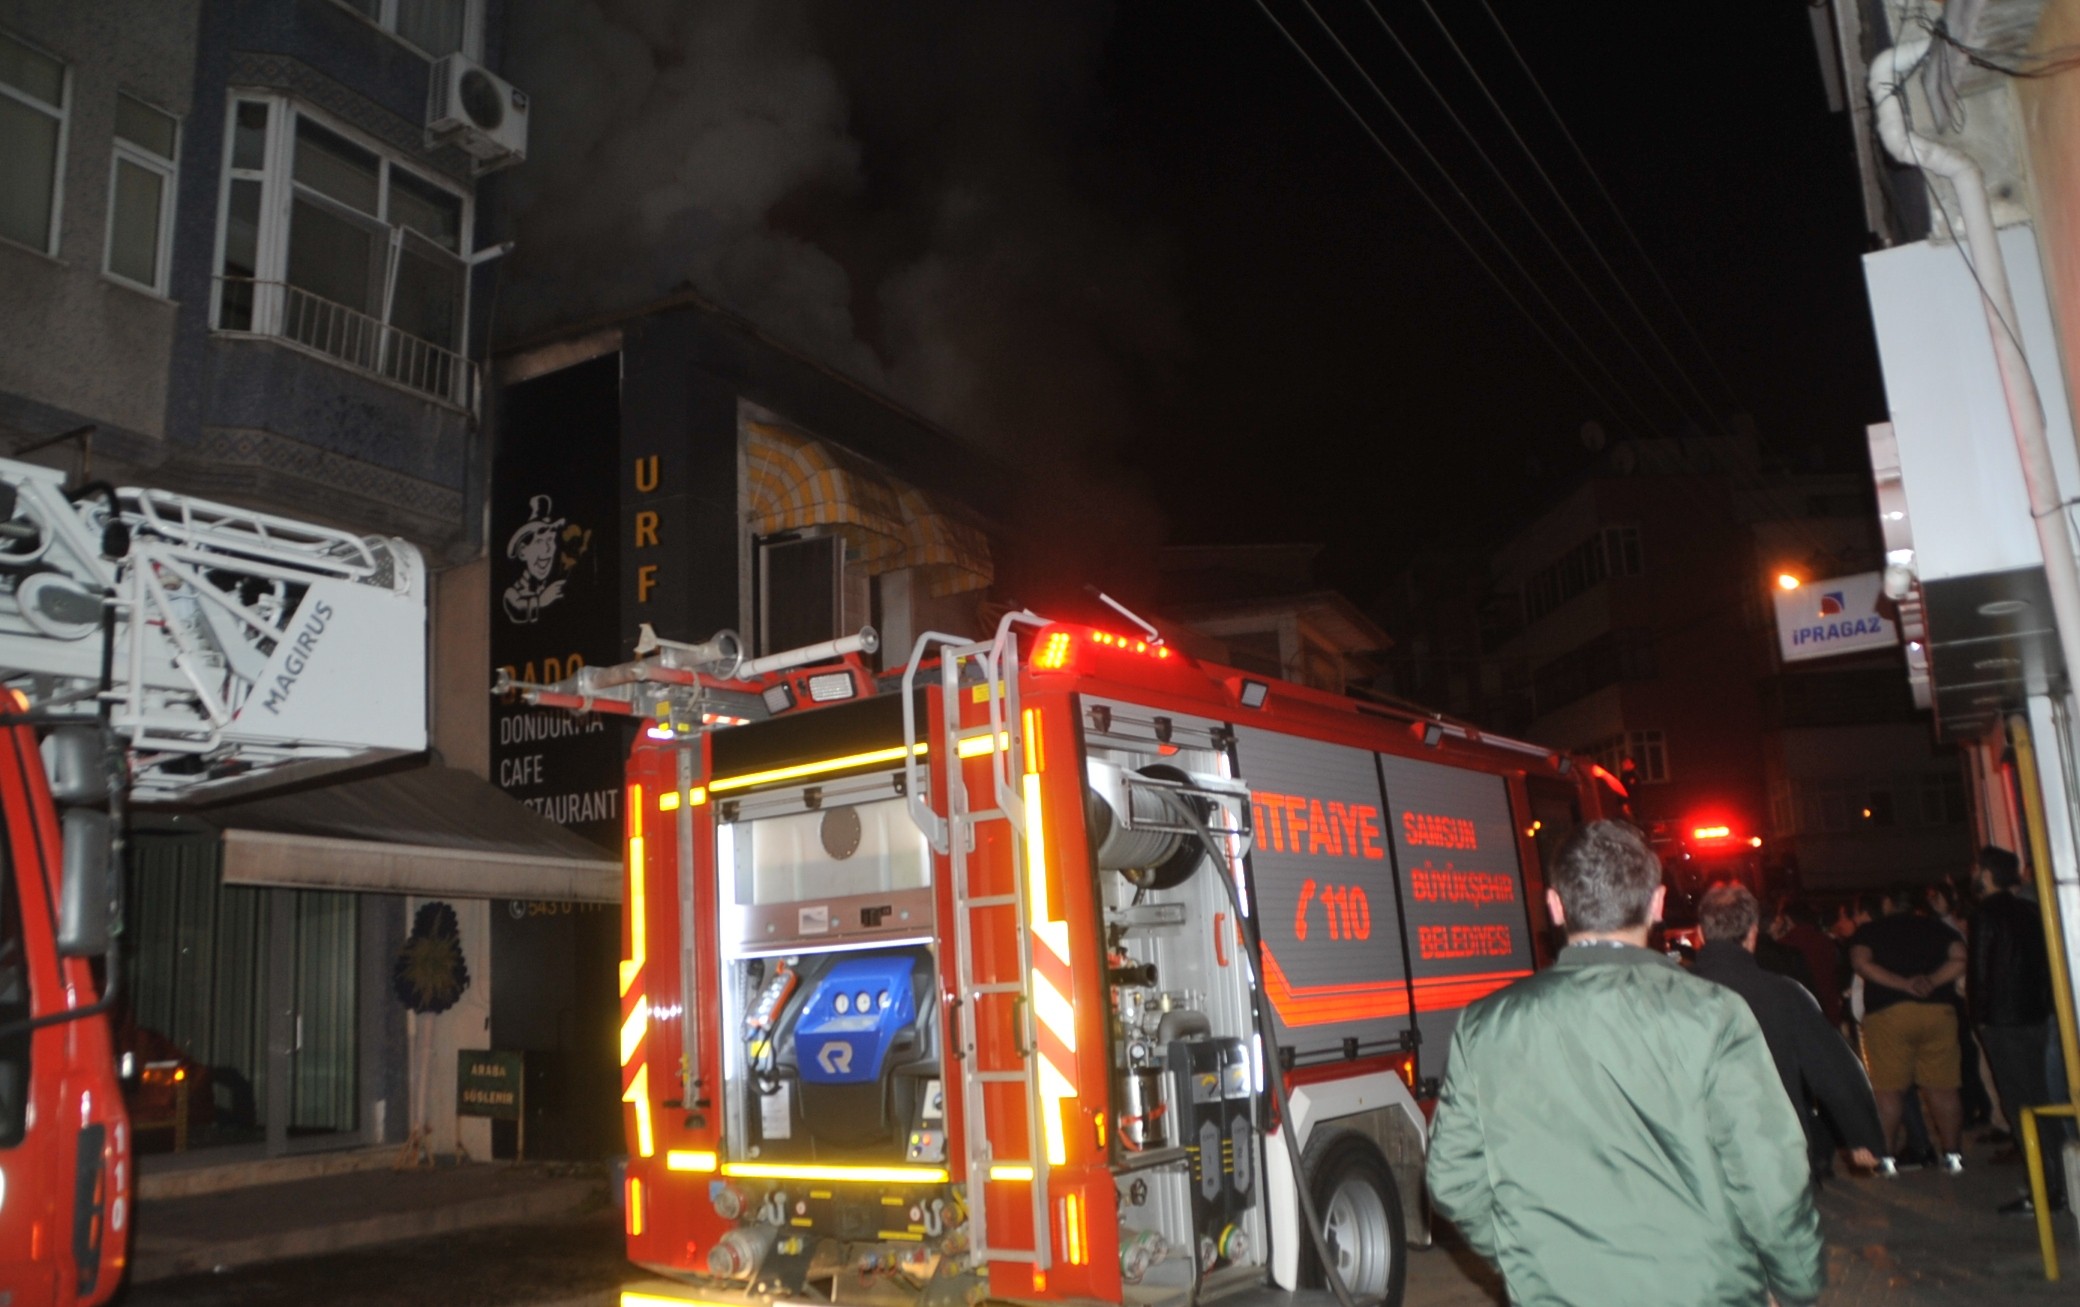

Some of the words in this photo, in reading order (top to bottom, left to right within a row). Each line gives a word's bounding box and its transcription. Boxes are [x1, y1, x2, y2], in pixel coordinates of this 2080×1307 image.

[634, 454, 662, 659] URF
[262, 599, 334, 716] MAGIRUS
[500, 754, 544, 788] CAFE
[1402, 810, 1478, 850] SAMSUN
[1320, 884, 1372, 941] 110
